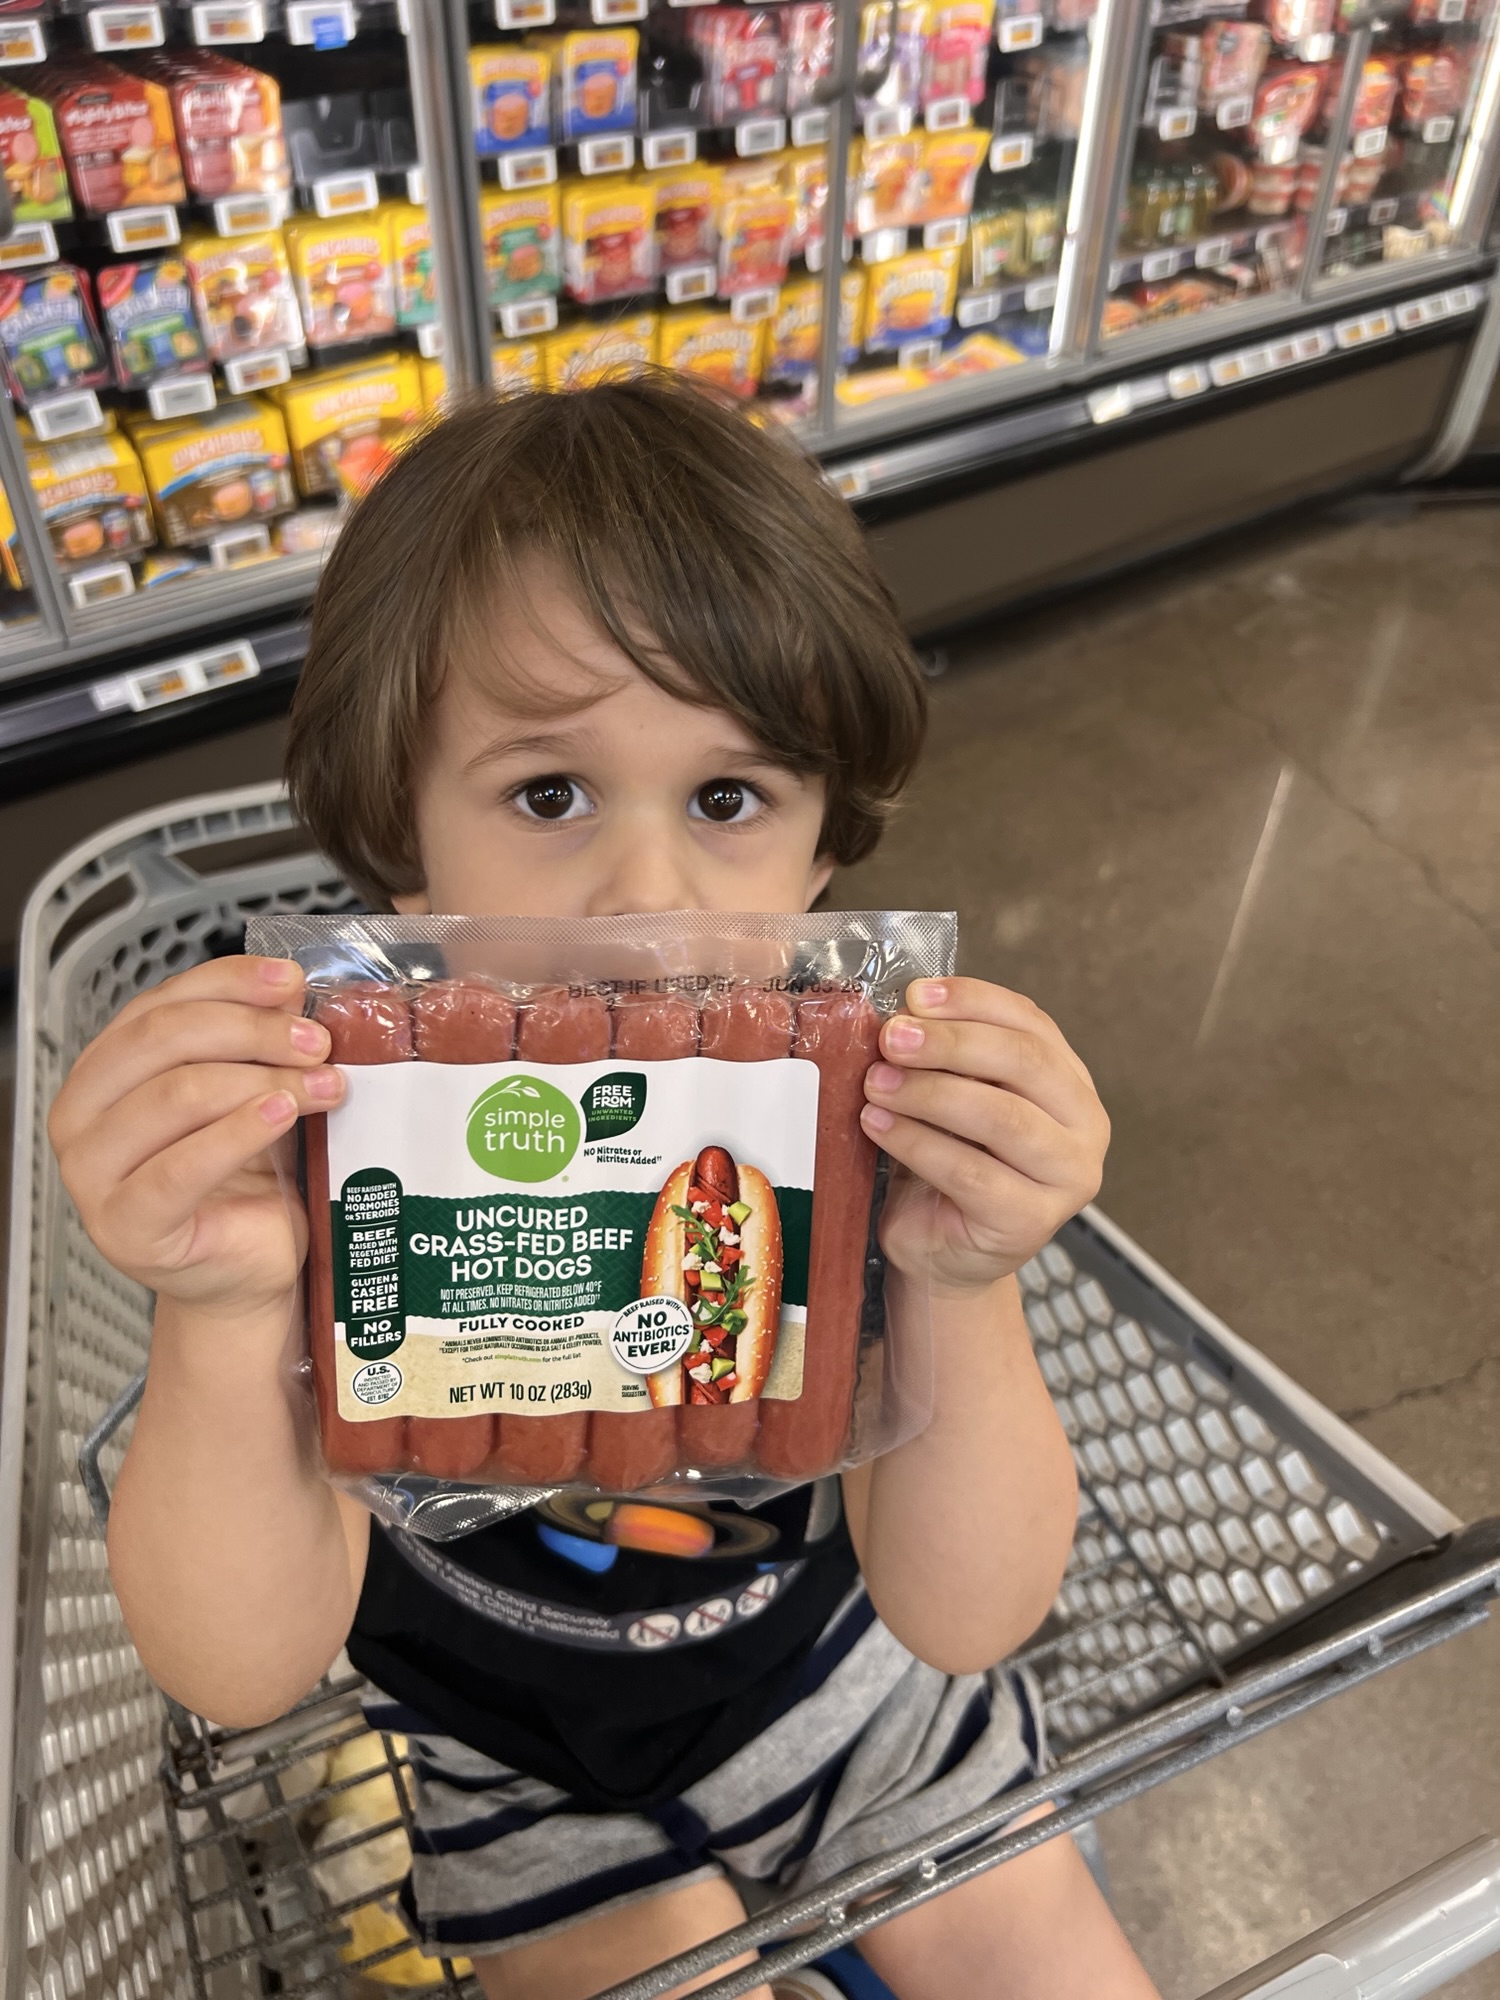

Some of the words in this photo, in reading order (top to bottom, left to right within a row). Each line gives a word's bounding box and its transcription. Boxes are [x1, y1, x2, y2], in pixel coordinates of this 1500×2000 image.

[630, 980, 647, 994] IF
[763, 976, 804, 993] JUN
[593, 1085, 632, 1097] FREE
[484, 1107, 565, 1129] simple
[484, 1129, 565, 1153] truth
[584, 1147, 596, 1157] NO
[597, 1146, 631, 1155] Nitrates
[597, 1155, 628, 1164] Nitrites
[347, 1193, 362, 1202] NO
[363, 1190, 397, 1201] ADDED
[345, 1199, 400, 1212] HORMONES
[355, 1207, 400, 1220] STEROIDS
[456, 1205, 588, 1232] UNCURED
[352, 1227, 396, 1242] BEEF
[409, 1231, 566, 1257] GRASS-FED
[572, 1228, 634, 1253] BEEF
[349, 1241, 377, 1250] RAISED
[378, 1238, 398, 1248] WITH
[350, 1246, 397, 1258] VEGETARIAN
[350, 1258, 371, 1268] FED
[451, 1257, 509, 1282] HOT
[515, 1255, 592, 1281] DOGS
[351, 1275, 389, 1287] GLUTEN
[391, 1273, 399, 1282] &
[351, 1282, 398, 1298] CASEIN
[441, 1289, 455, 1300] NOT
[455, 1284, 496, 1300] PRESERVED.
[496, 1284, 514, 1295] KEEP
[514, 1285, 561, 1298] REFRIGERATED
[561, 1282, 585, 1297] BELOW
[352, 1294, 399, 1313] FREE
[442, 1302, 451, 1313] AT
[452, 1301, 465, 1313] ALL
[466, 1298, 489, 1312] TIMES.
[489, 1297, 500, 1308] NO
[501, 1297, 532, 1310] NITRATES
[533, 1300, 543, 1311] OR
[543, 1298, 573, 1311] NITRITES
[622, 1304, 640, 1318] BEEF
[640, 1298, 665, 1309] RAISED
[665, 1298, 682, 1311] WITH
[363, 1319, 392, 1335] NO
[459, 1317, 508, 1333] FULLY
[512, 1316, 585, 1332] COOKED
[638, 1311, 667, 1329] NO
[351, 1331, 402, 1347] FILLERS
[470, 1344, 484, 1352] THOSE
[511, 1343, 535, 1351] OCCURRING
[566, 1341, 581, 1349] CELERY
[483, 1335, 515, 1343] ADMINISTERED
[515, 1336, 542, 1345] ANTIBIOTICS
[550, 1336, 568, 1344] ANIMAL
[628, 1339, 676, 1358] EVER!
[367, 1365, 390, 1376] U.S.
[357, 1384, 390, 1392] DEPARTMENT
[370, 1378, 389, 1386] PASSED
[450, 1385, 476, 1403] NET
[480, 1382, 505, 1399] WT
[510, 1383, 524, 1400] 10
[528, 1385, 546, 1401] OZ
[550, 1380, 592, 1403] (283g)
[495, 1590, 537, 1612] Child
[541, 1605, 612, 1630] Securely
[526, 1611, 620, 1640] Unattended
